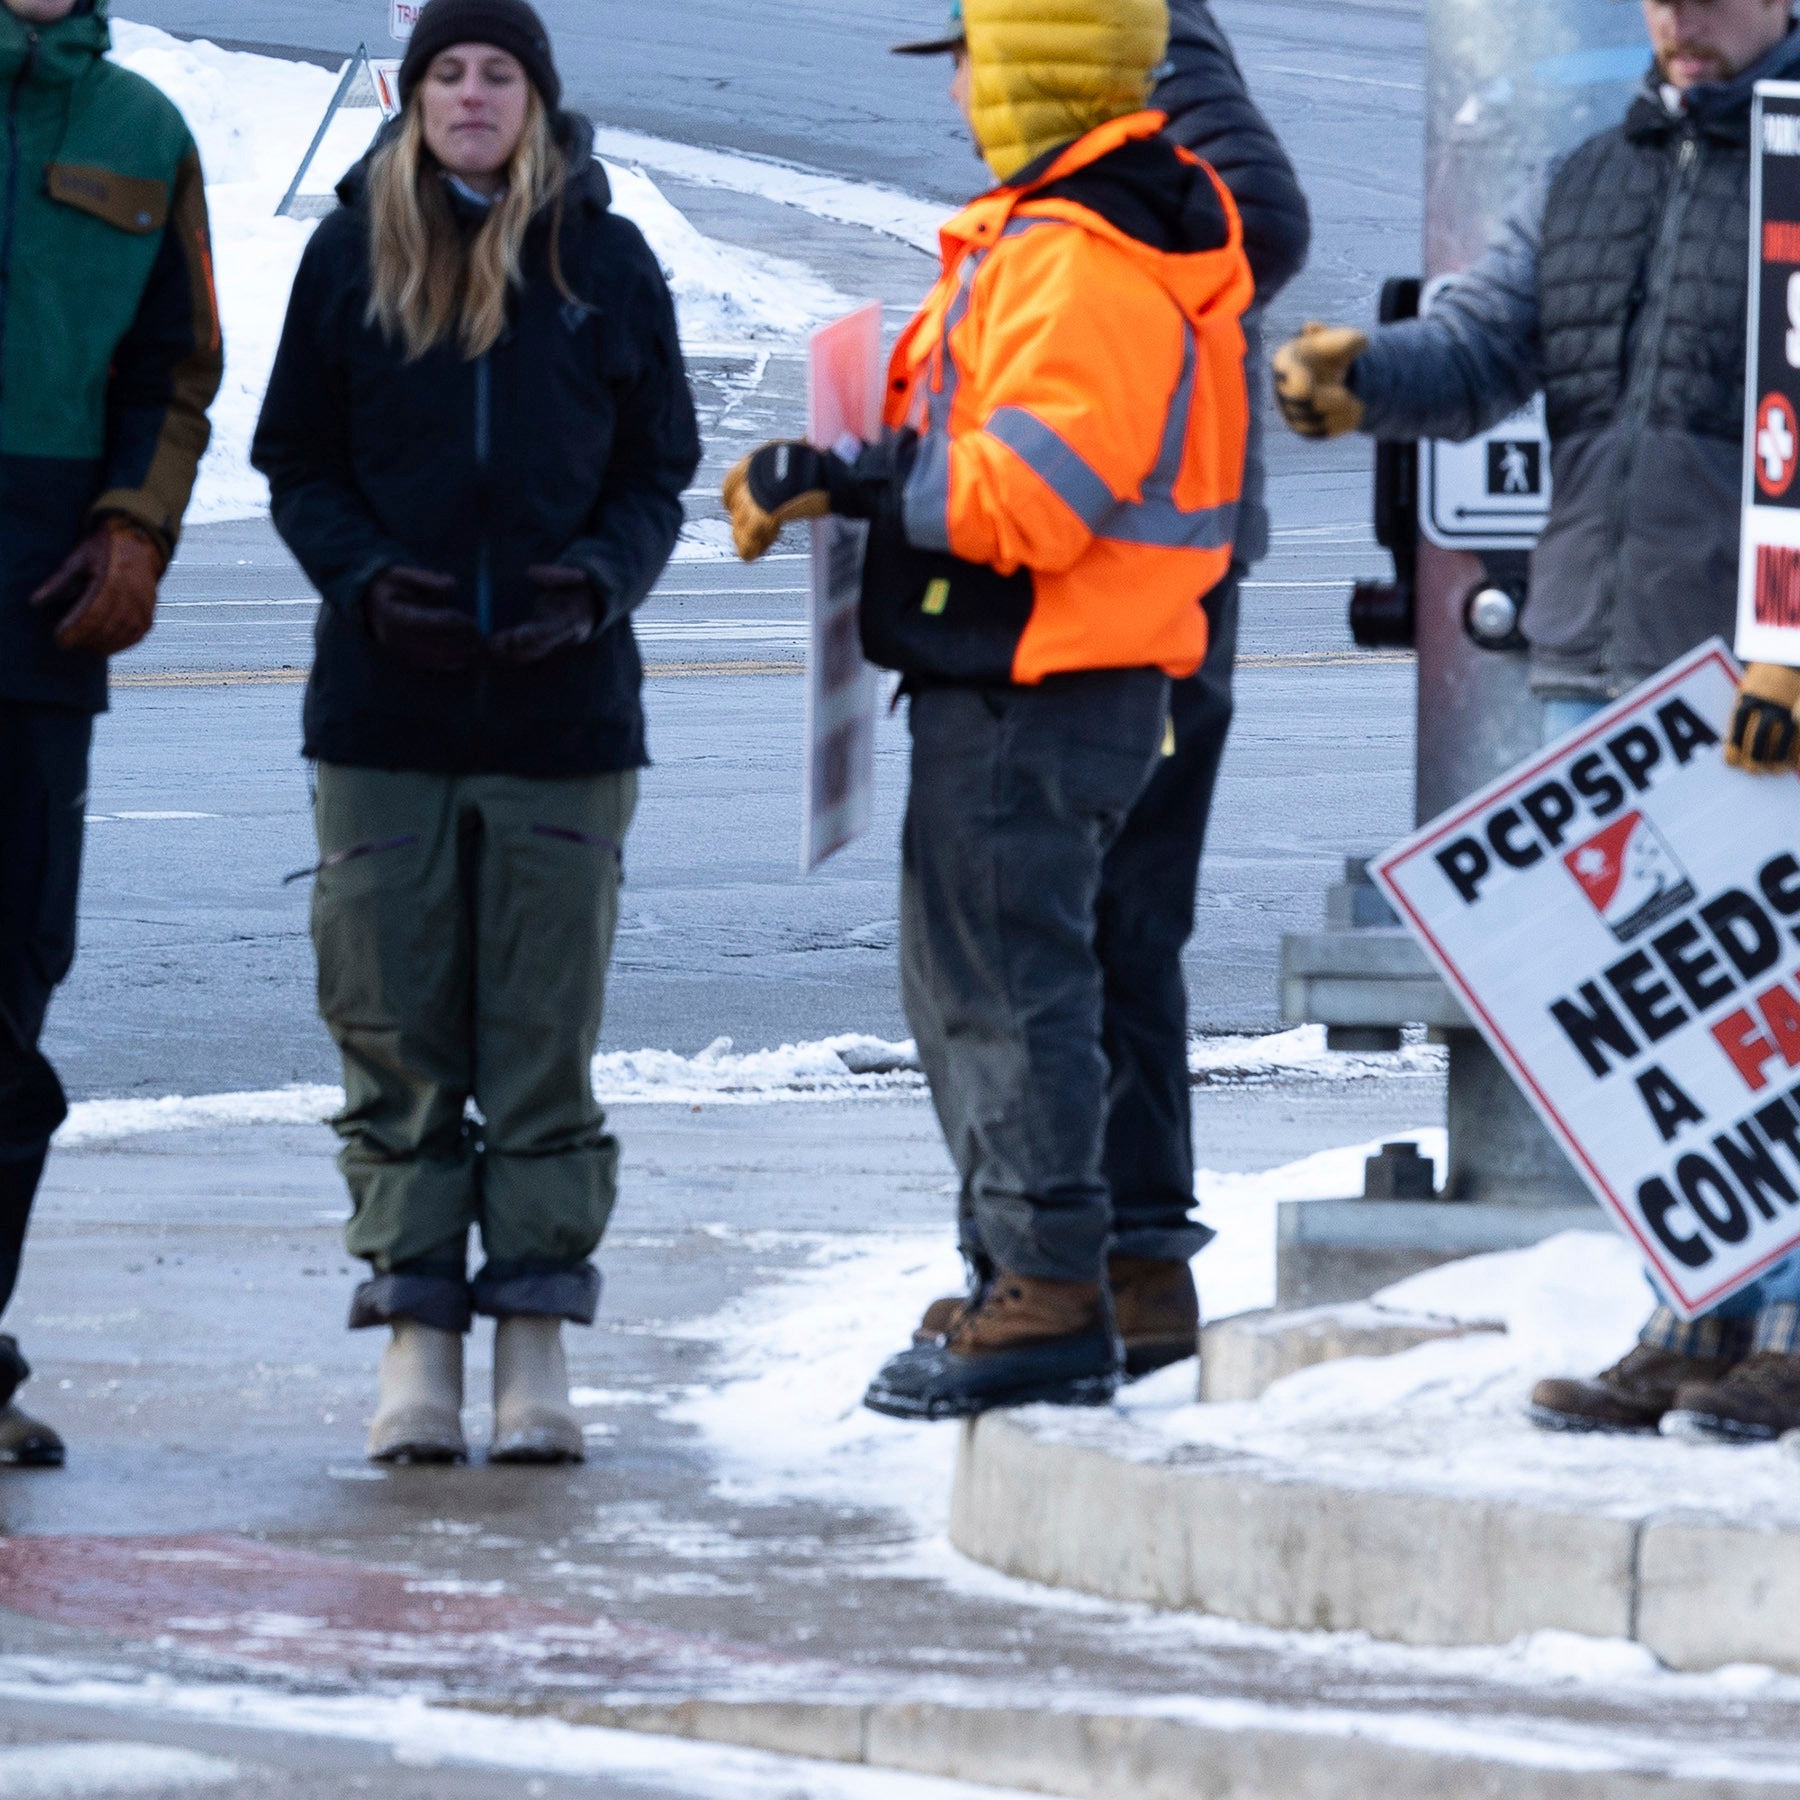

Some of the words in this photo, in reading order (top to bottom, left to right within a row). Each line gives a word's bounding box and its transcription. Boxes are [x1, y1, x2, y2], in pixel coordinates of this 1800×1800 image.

[1433, 696, 1720, 906] PCPSPA
[1636, 1065, 1706, 1142] A
[1711, 968, 1800, 1091] FA
[1637, 1084, 1800, 1268] CONT
